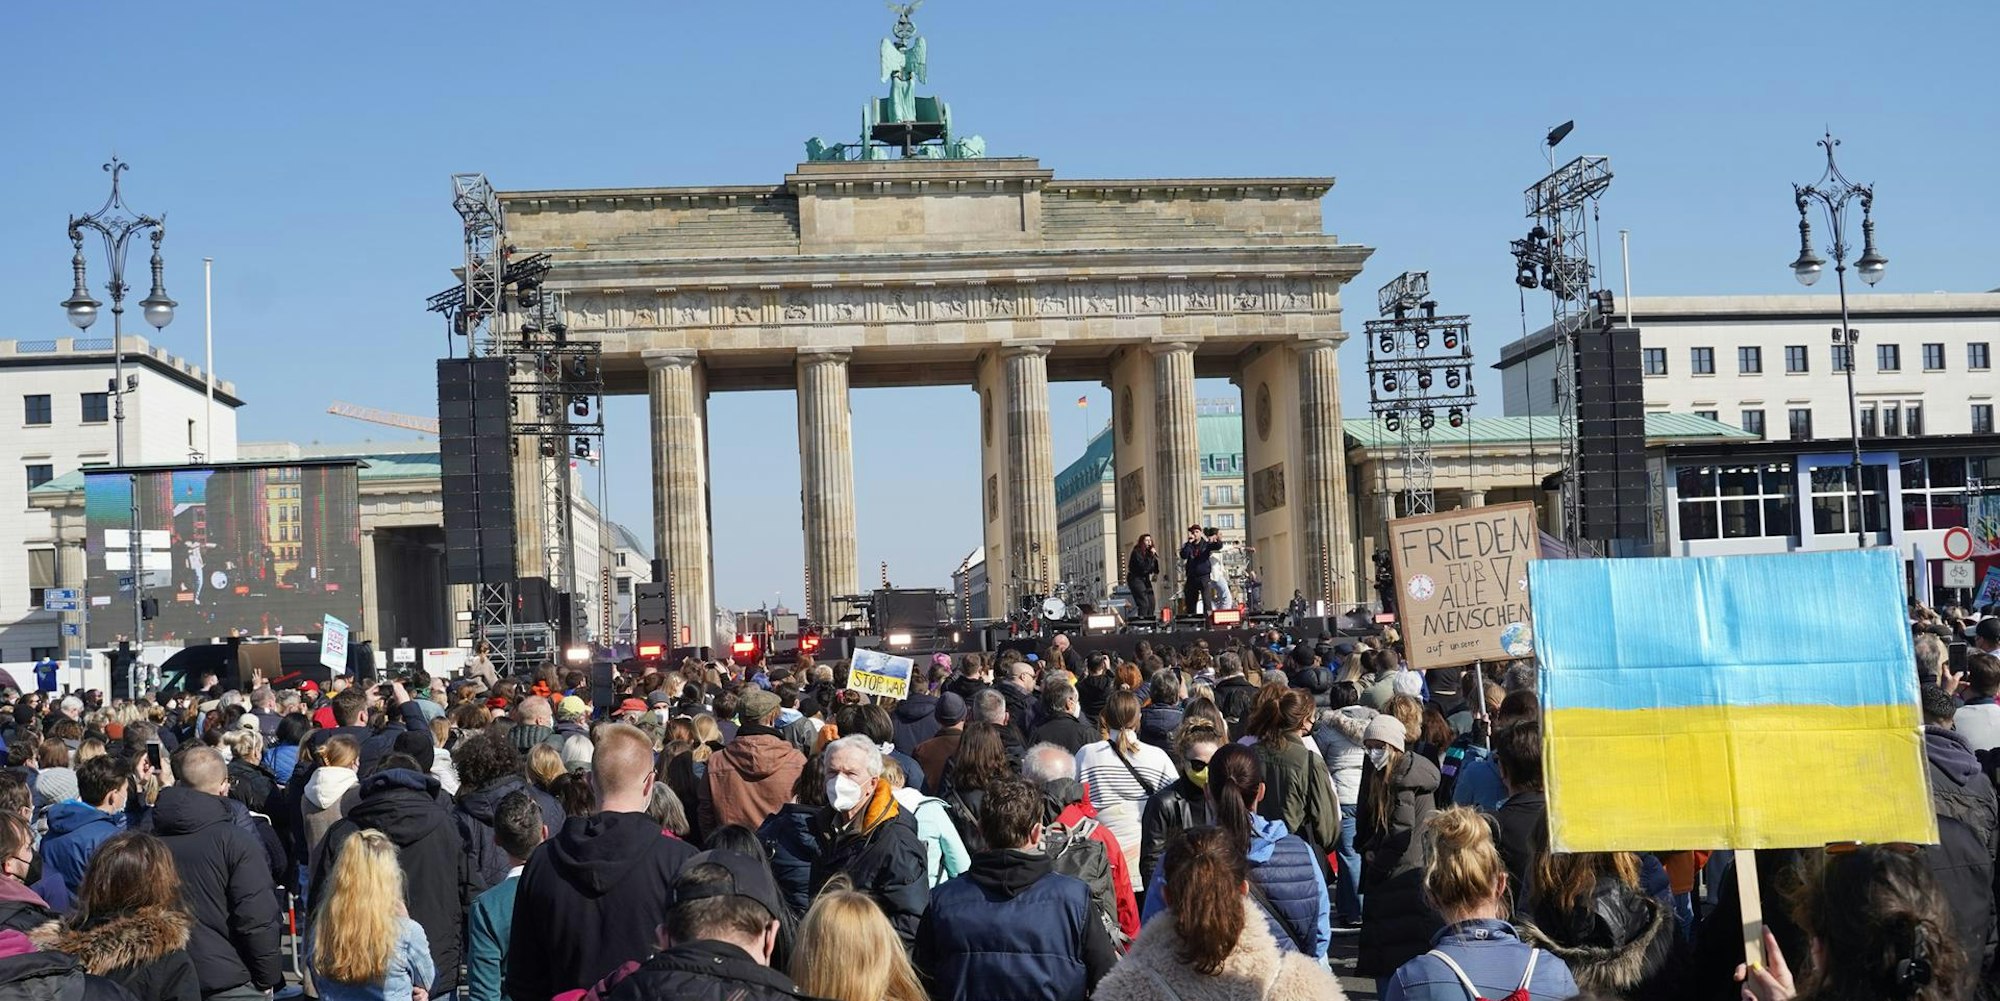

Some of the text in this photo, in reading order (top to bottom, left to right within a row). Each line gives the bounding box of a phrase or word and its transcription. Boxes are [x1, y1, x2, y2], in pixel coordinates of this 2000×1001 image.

[1400, 513, 1531, 568] FRIEDEN
[1445, 560, 1486, 584] FÜR
[1439, 580, 1488, 610] ALLE
[1423, 603, 1532, 636] MENSCHEN
[1426, 639, 1481, 657] auf unserer
[853, 671, 907, 696] STOP WAR
